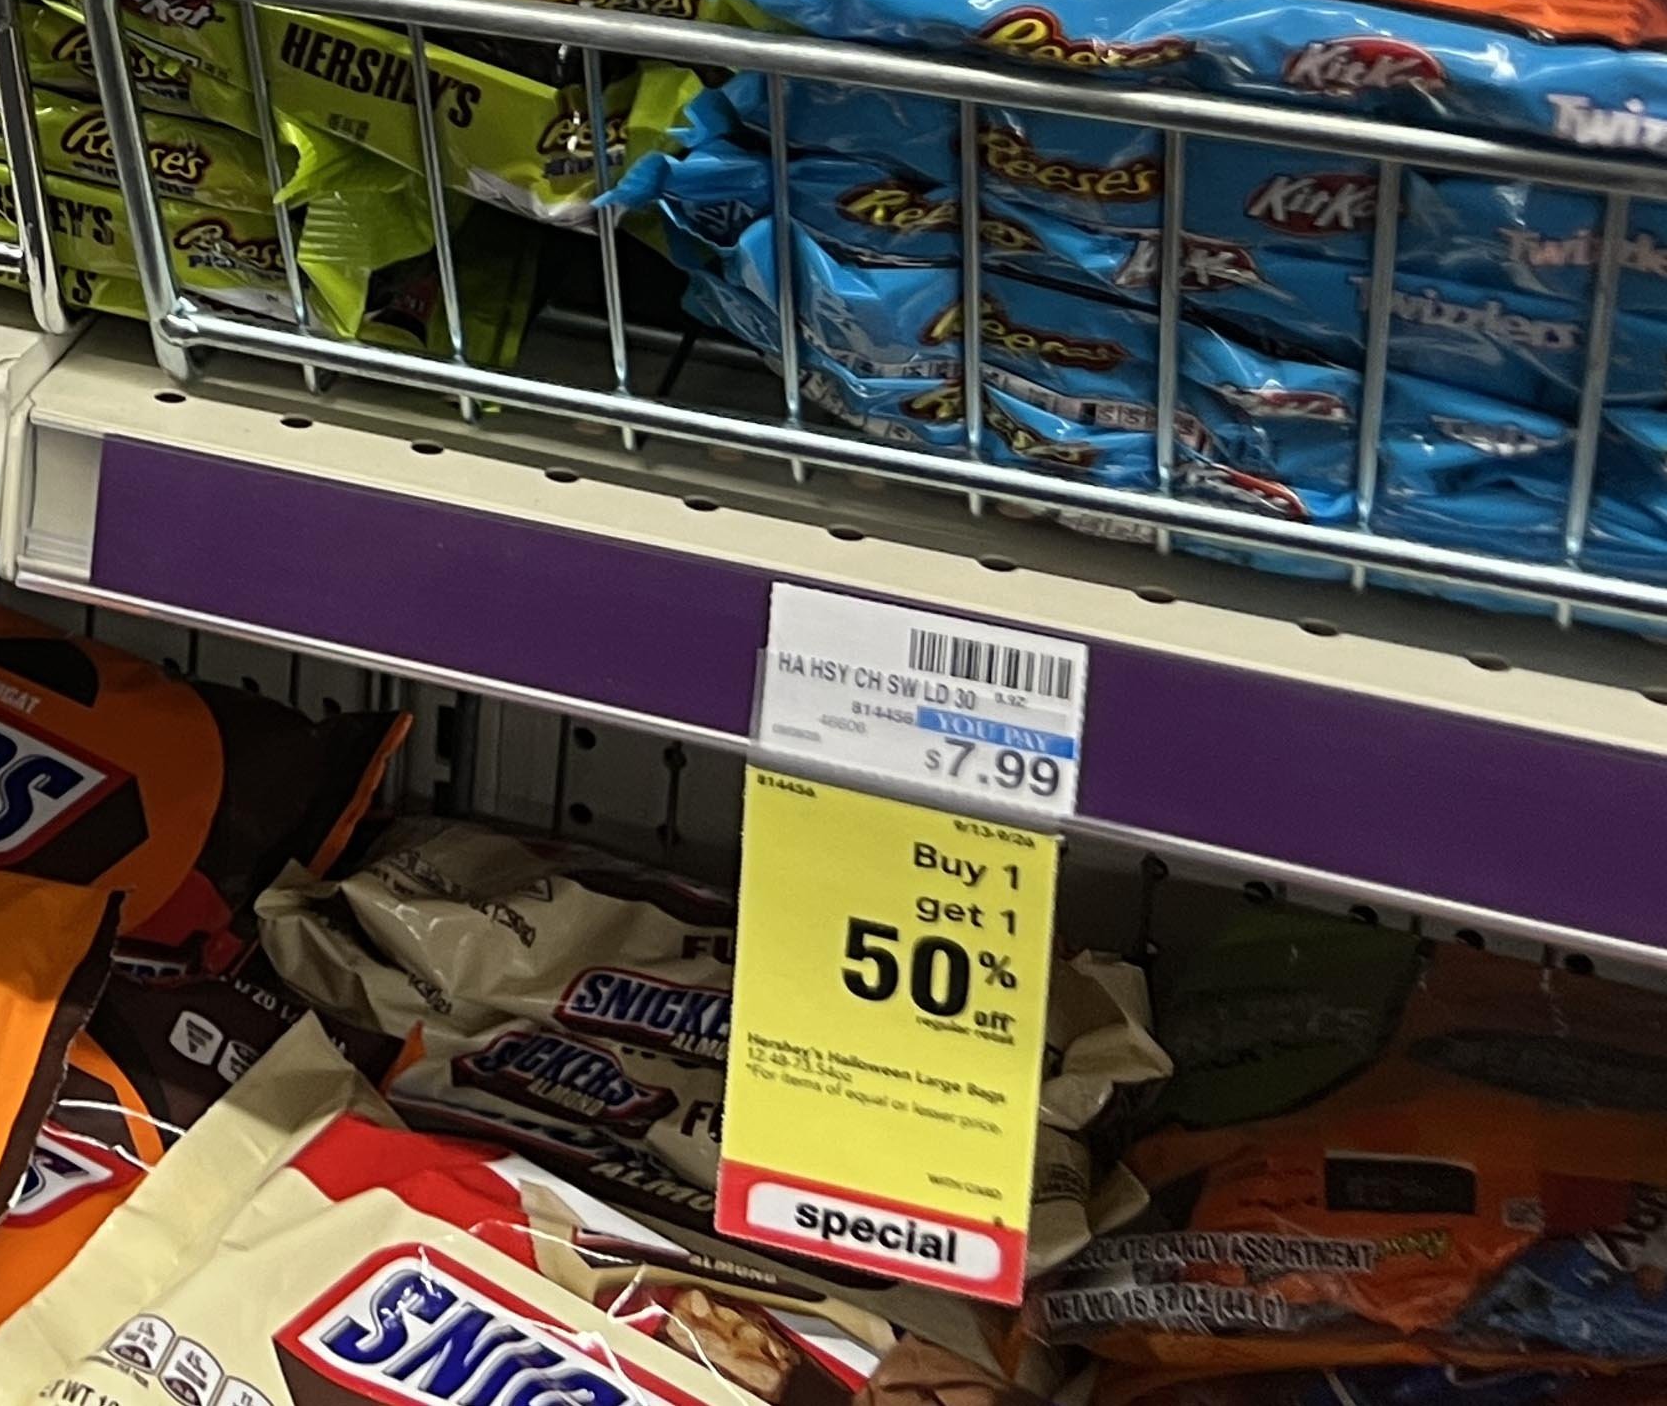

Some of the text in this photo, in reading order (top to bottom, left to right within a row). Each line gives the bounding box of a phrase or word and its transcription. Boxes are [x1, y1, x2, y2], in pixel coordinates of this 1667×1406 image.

[778, 650, 979, 712] HA HSY CH SW LD 30
[923, 735, 1062, 798] $7.99
[912, 840, 1021, 892] Buy 1
[915, 895, 1018, 938] get 1
[840, 914, 1019, 1018] 50%
[827, 1047, 964, 1096] Halloween Large
[793, 1199, 960, 1266] special
[1228, 1233, 1374, 1271] ASSORTMENT
